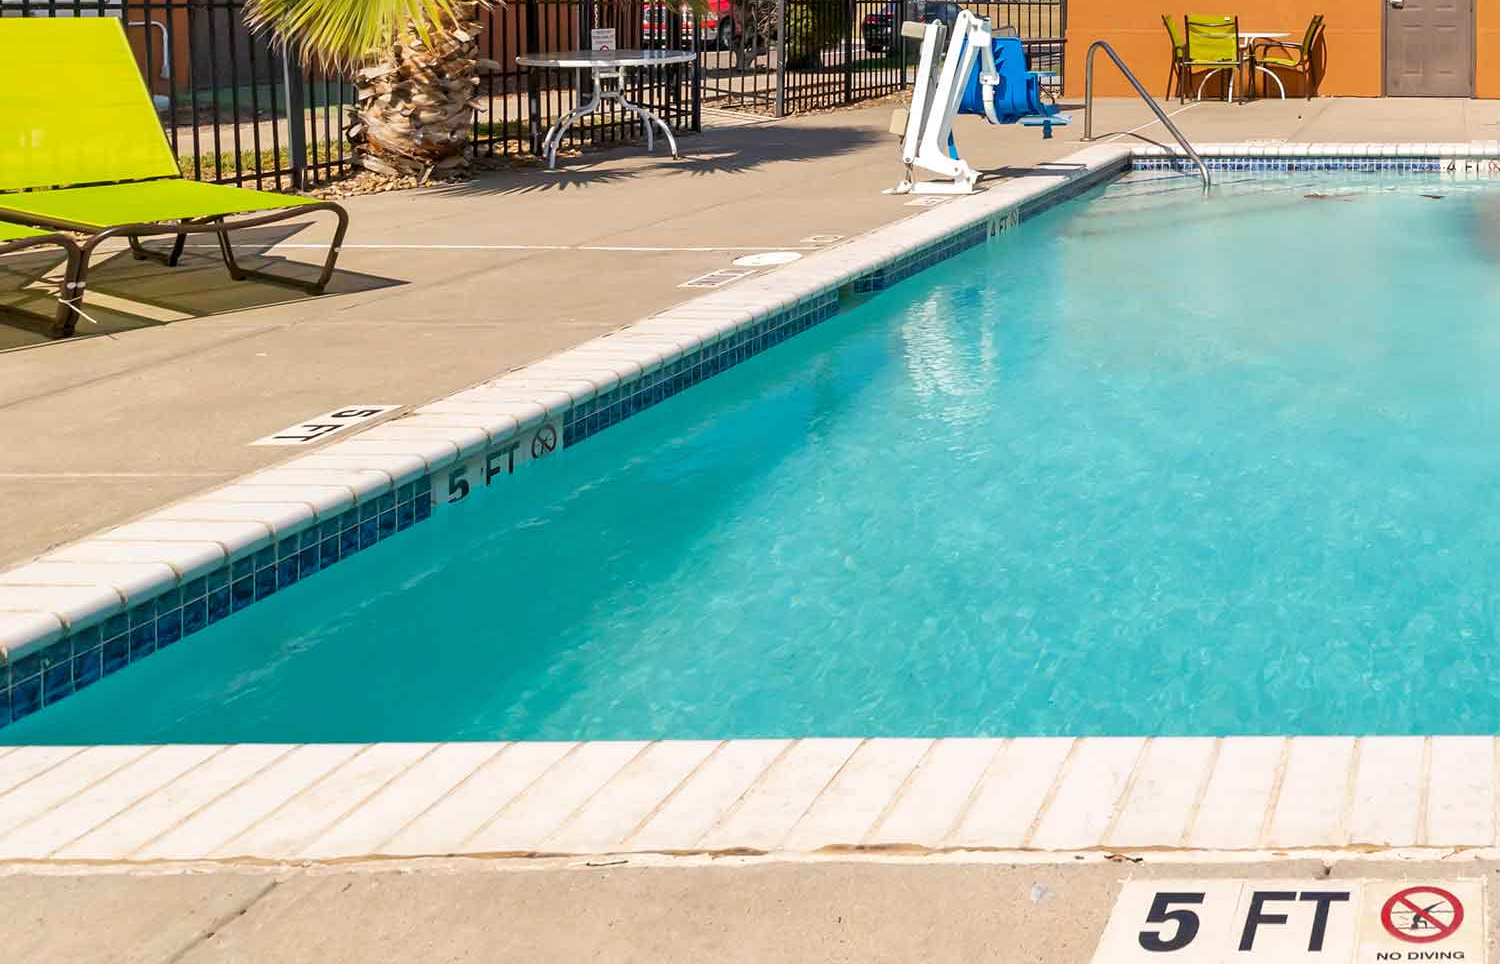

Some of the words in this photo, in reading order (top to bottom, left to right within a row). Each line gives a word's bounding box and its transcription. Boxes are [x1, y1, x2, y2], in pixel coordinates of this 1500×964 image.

[1446, 161, 1456, 171] 4
[331, 408, 383, 418] 5
[274, 423, 344, 442] FT
[448, 467, 469, 504] 5
[486, 441, 520, 487] FT
[1138, 892, 1206, 952] 5
[1238, 891, 1350, 952] FT
[1376, 951, 1402, 961] NO
[1407, 951, 1465, 961] DIVING
